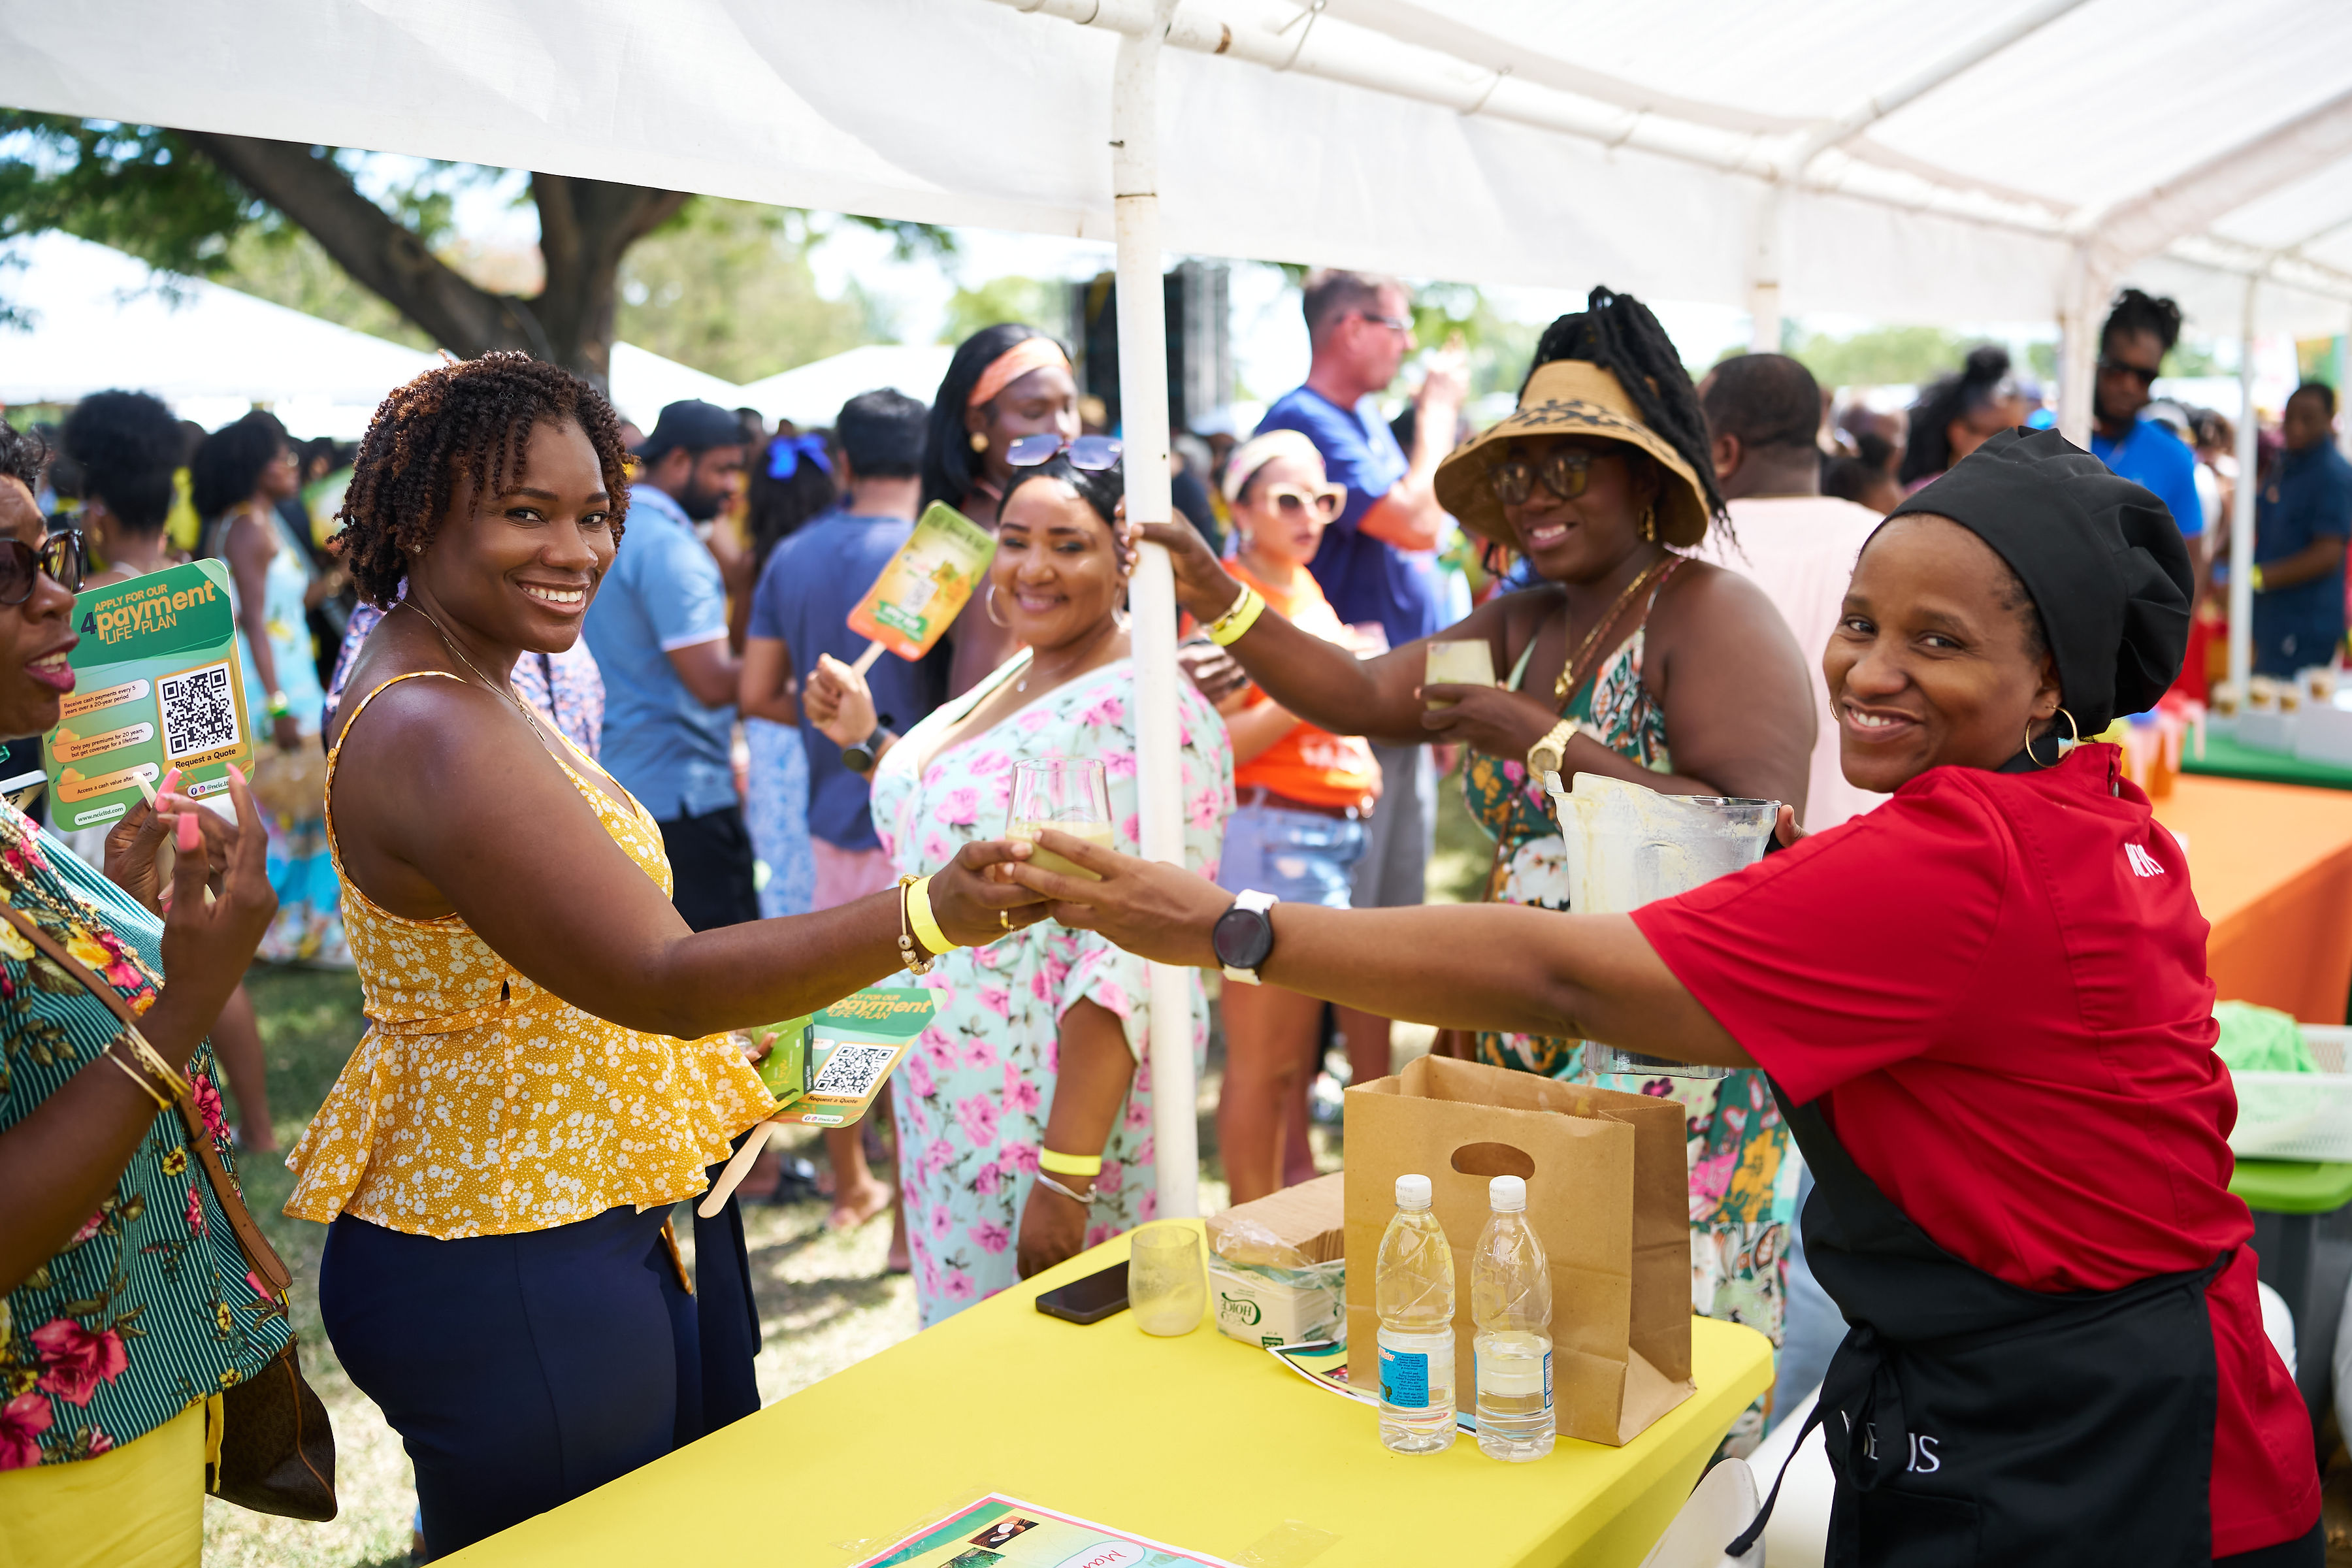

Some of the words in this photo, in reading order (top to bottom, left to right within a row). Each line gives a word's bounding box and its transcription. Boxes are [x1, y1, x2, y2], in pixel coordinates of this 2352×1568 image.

[94, 595, 123, 613] APPLY
[125, 591, 144, 604] FOR
[146, 583, 168, 597] OUR
[80, 612, 97, 635] 4
[96, 580, 216, 640] payment
[105, 625, 133, 645] LIFE
[141, 613, 177, 635] PLAN
[94, 699, 112, 708] 20-year
[114, 694, 129, 702] period
[95, 691, 117, 702] payments
[90, 744, 110, 753] coverage
[122, 736, 139, 744] lifetime
[91, 737, 114, 747] premiums
[175, 756, 205, 768] Request
[214, 749, 236, 759] Quote
[207, 781, 229, 790] @ncic.lt
[78, 807, 123, 822] www.ncicltd.com
[826, 1000, 932, 1015] payment
[828, 1009, 854, 1018] LIFE
[1221, 1292, 1261, 1326] CHOICE
